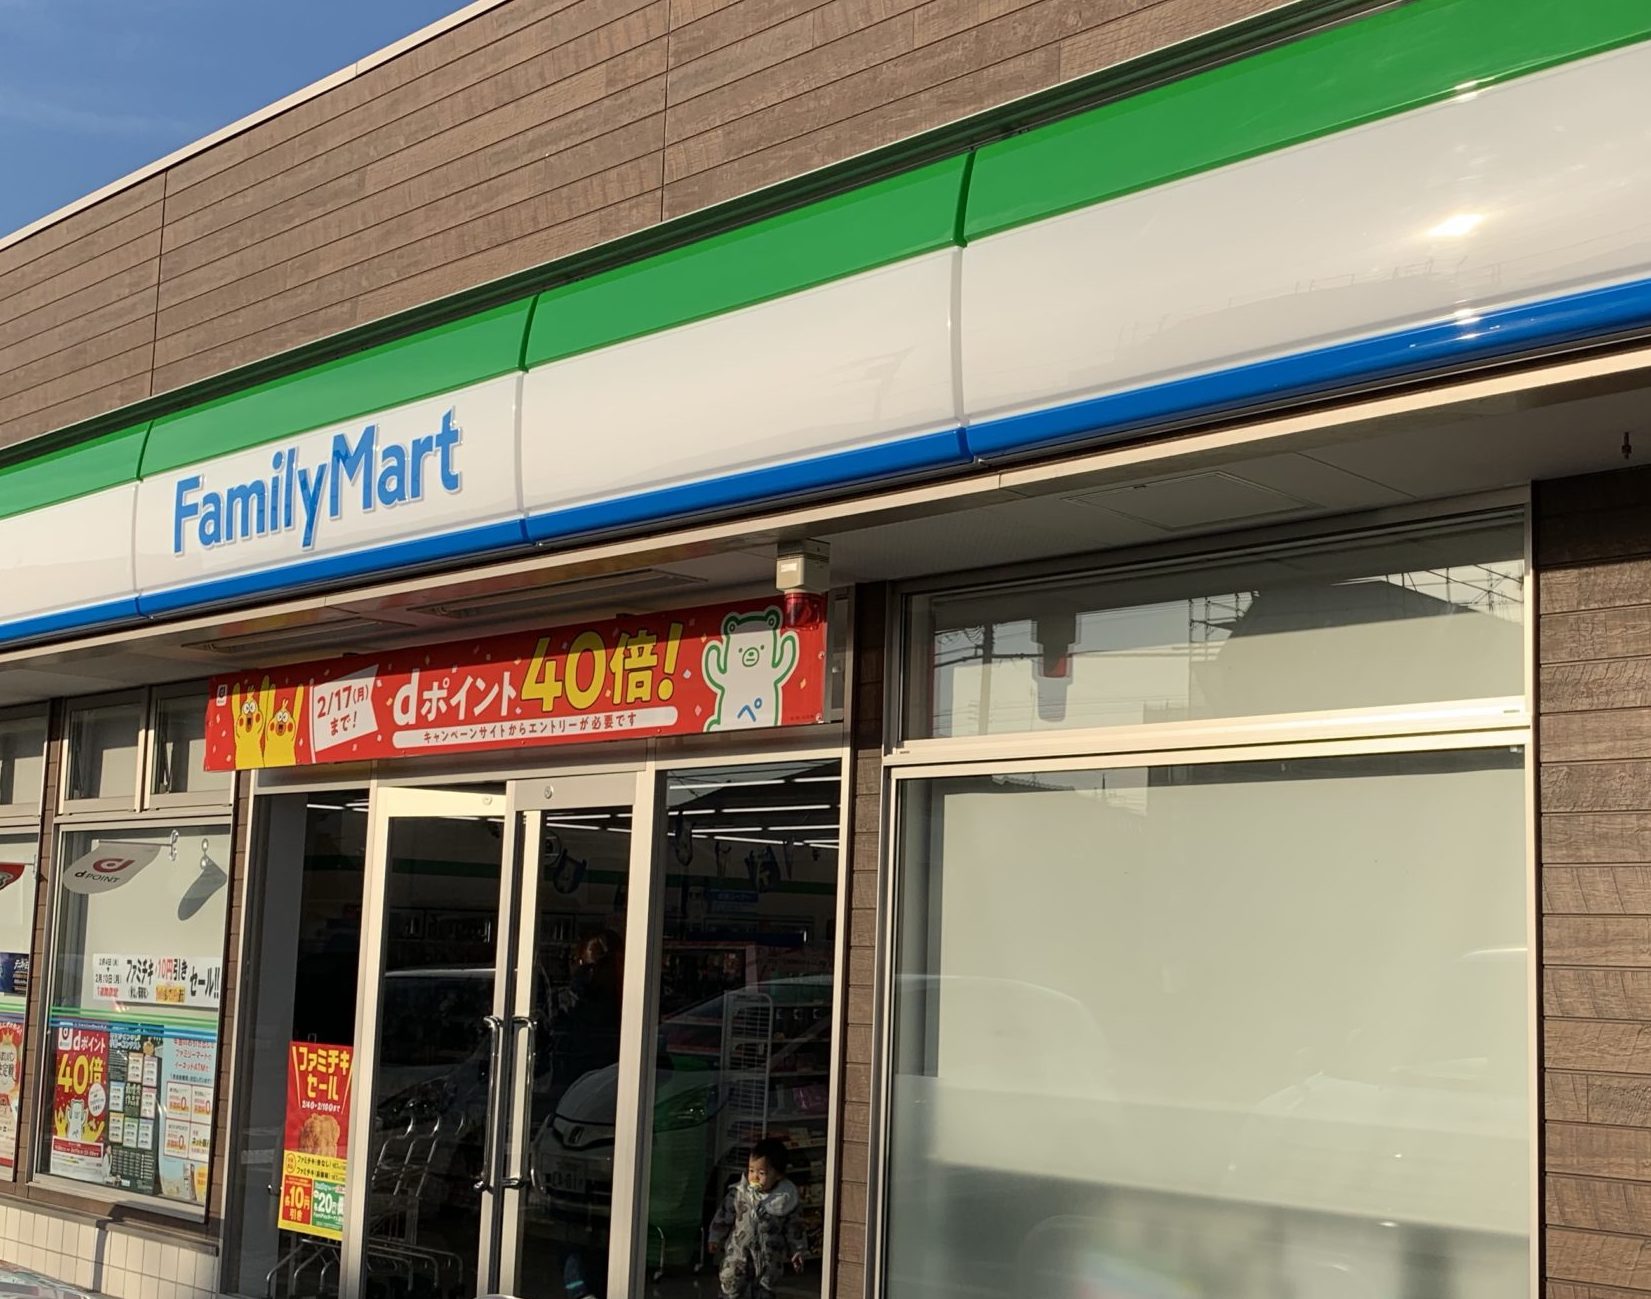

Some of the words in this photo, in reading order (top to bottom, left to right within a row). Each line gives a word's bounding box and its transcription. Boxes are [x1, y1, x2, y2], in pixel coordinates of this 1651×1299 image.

[173, 406, 463, 554] FamilyMart
[393, 668, 516, 726] dポイント
[521, 622, 684, 713] 40倍!
[317, 684, 369, 718] 2/17(月)
[329, 710, 358, 737] まで!
[424, 712, 637, 744] キャンペーンサイトからエントリーが必要です
[58, 1053, 104, 1095] 40倍
[299, 1046, 350, 1075] ファミチキ
[307, 1073, 339, 1101] セール
